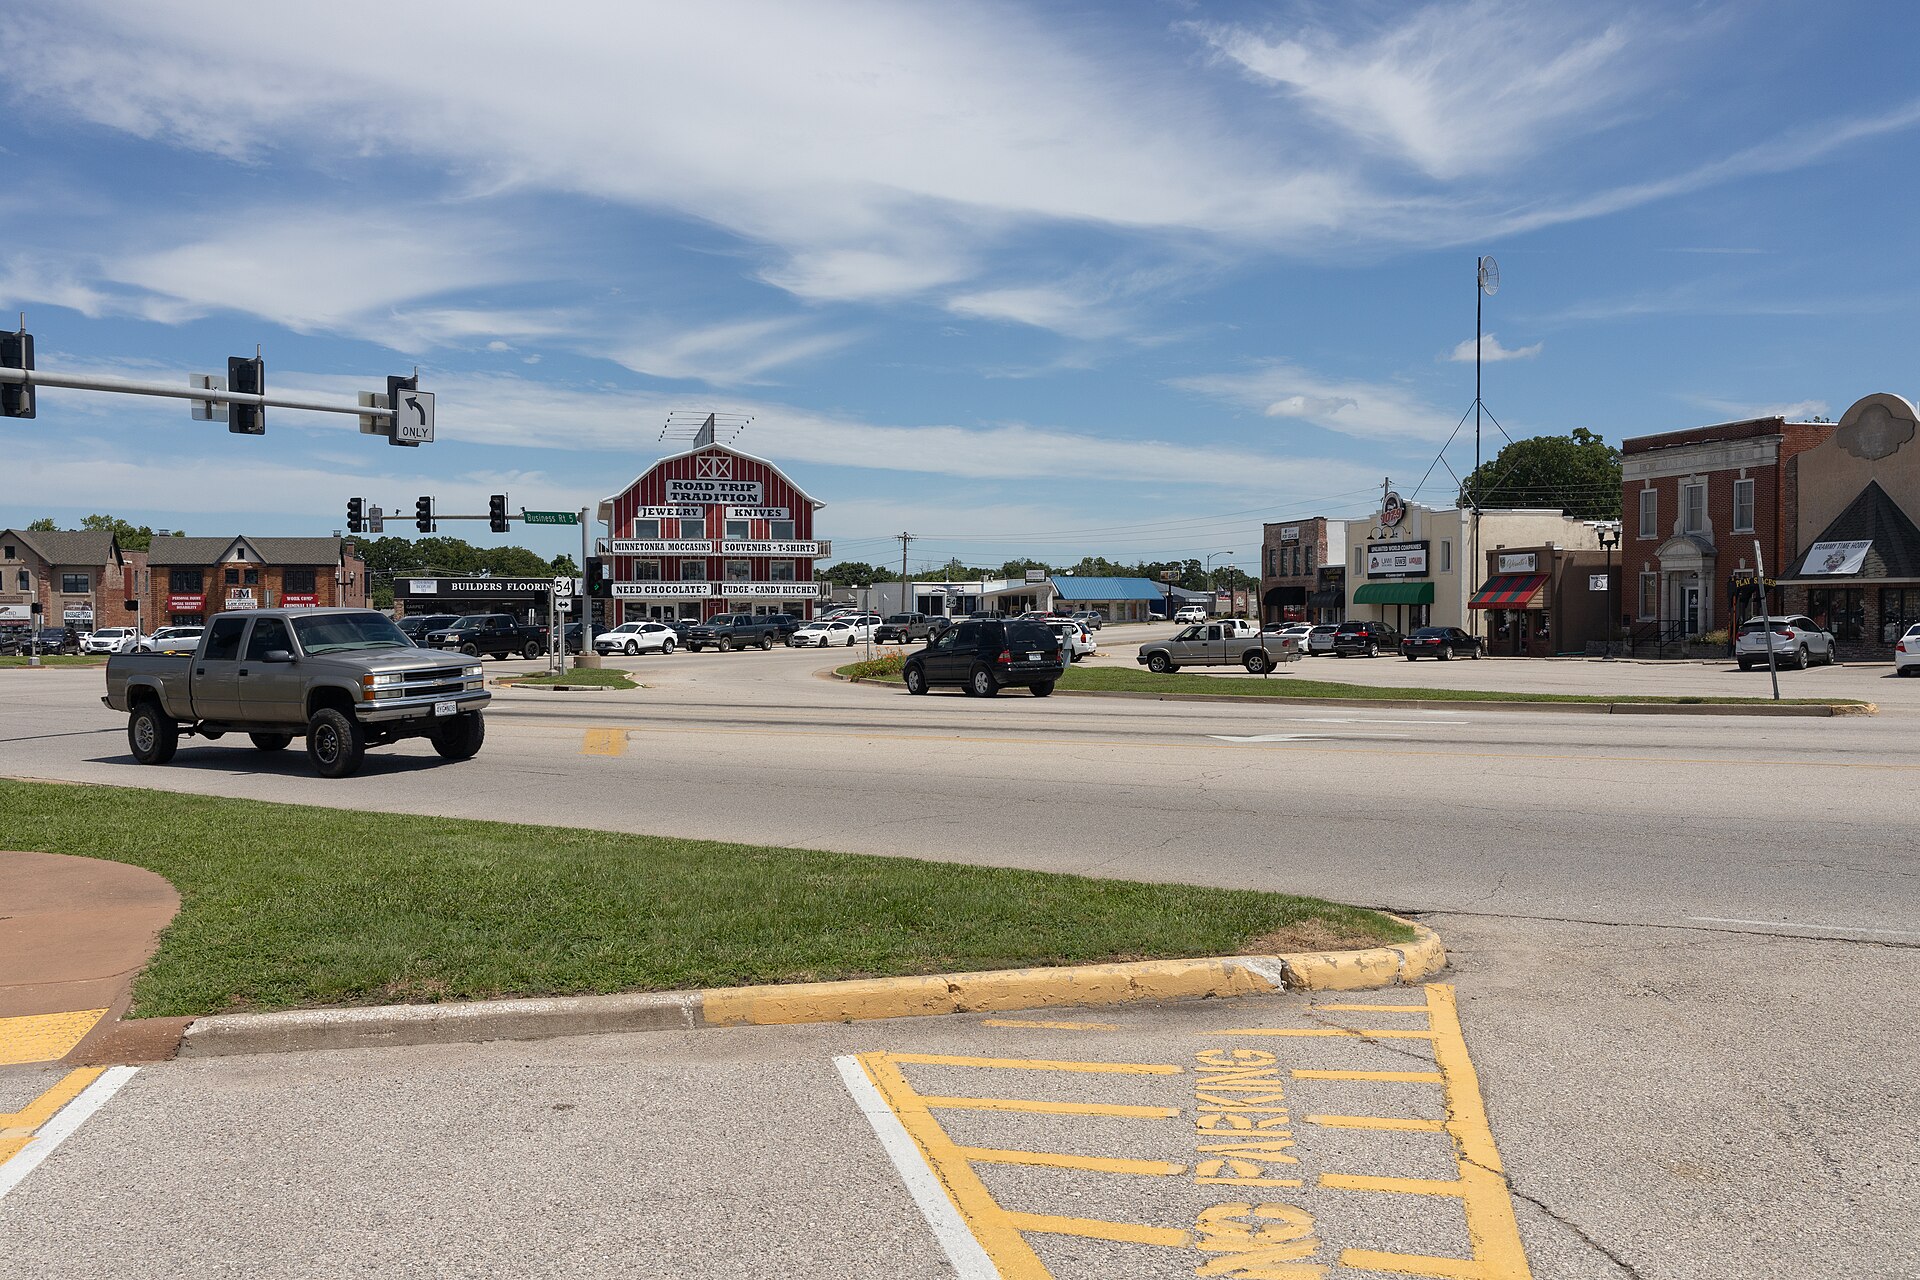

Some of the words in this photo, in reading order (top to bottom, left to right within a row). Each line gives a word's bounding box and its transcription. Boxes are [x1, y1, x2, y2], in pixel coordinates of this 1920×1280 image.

[402, 426, 428, 438] ONLY
[672, 482, 715, 491] ROAD
[719, 483, 757, 492] TRIP
[670, 492, 758, 502] TRADITION
[642, 508, 698, 518] JEWELRY
[734, 509, 782, 517] KNIVES
[526, 514, 556, 522] Business
[558, 514, 566, 522] Rt
[569, 514, 574, 522] 5
[614, 542, 665, 551] MINNETONKA
[668, 542, 710, 551] MOCCASINS
[724, 543, 772, 552] SOUVENIRS
[778, 544, 816, 552] T-SHIRTS
[1814, 542, 1837, 550] GRAMMY
[451, 582, 502, 591] BUILDERS
[556, 580, 570, 592] 54
[1736, 578, 1750, 588] PLAY
[616, 586, 642, 594] NEED
[644, 586, 707, 594] CHOCOLATE?
[723, 586, 748, 594] FUDGE
[754, 586, 780, 594] CANDY
[782, 586, 817, 594] KITCHEN
[1194, 1048, 1303, 1187] PARKING
